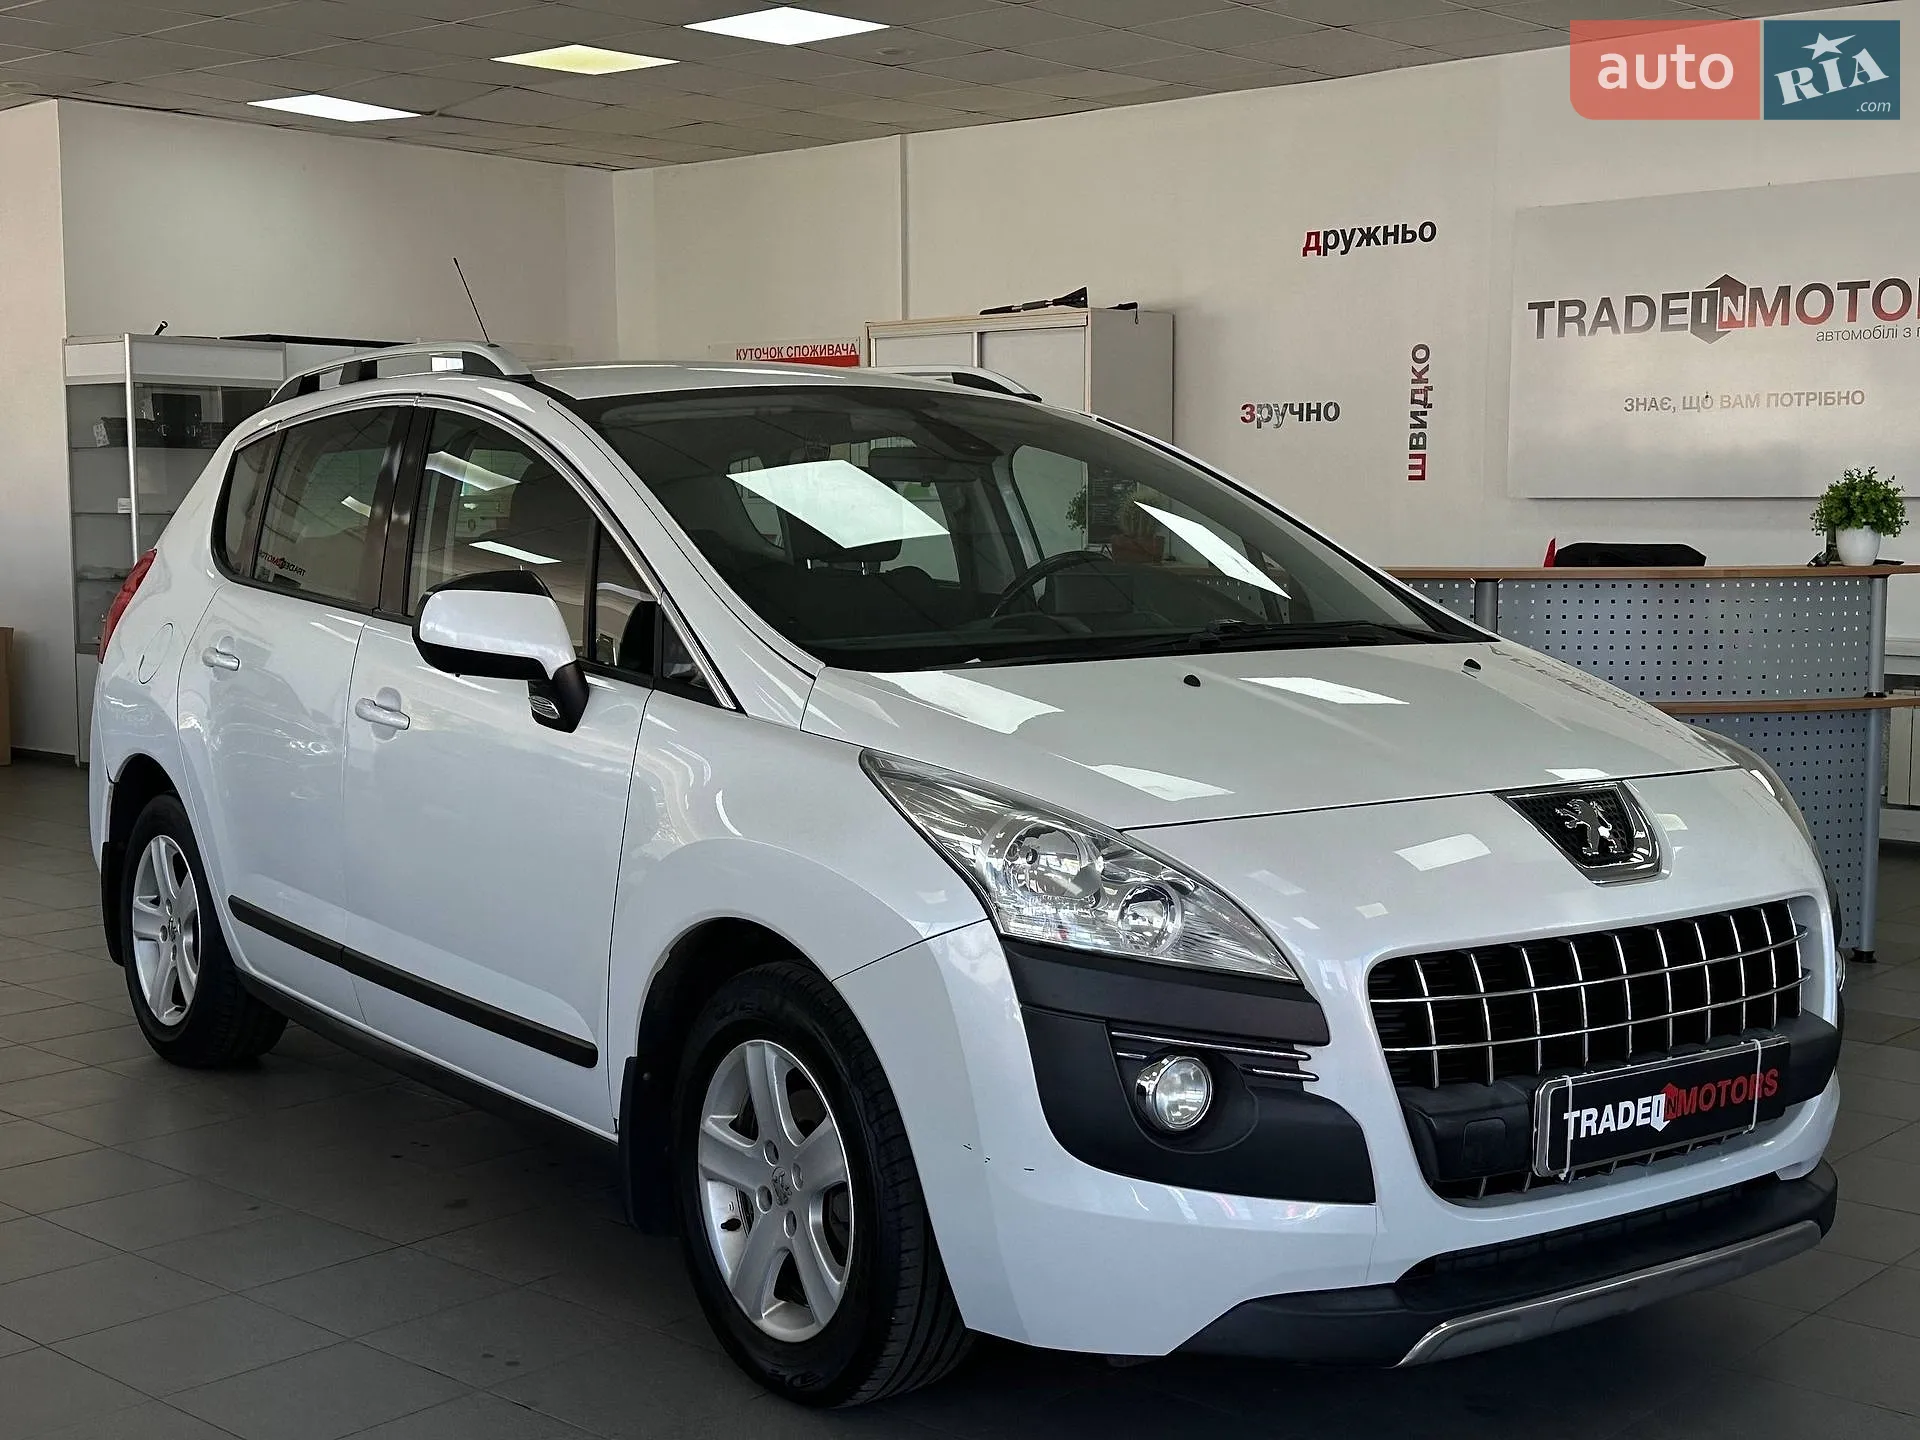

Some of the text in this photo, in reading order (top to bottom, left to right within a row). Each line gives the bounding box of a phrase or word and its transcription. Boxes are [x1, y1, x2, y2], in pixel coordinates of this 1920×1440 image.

[1302, 221, 1437, 257] дружньо
[1528, 275, 1920, 344] TRADEINMOTO
[1816, 325, 1898, 341] автомобілі
[1903, 327, 1911, 337] з
[736, 343, 857, 360] КУТОЧОК СПОЖИВАЧА
[1240, 401, 1340, 428] зручно
[1408, 343, 1433, 481] швидко
[1623, 390, 1865, 413] ЗНАЄ, ЩО ВАМ ПОТРІБНО
